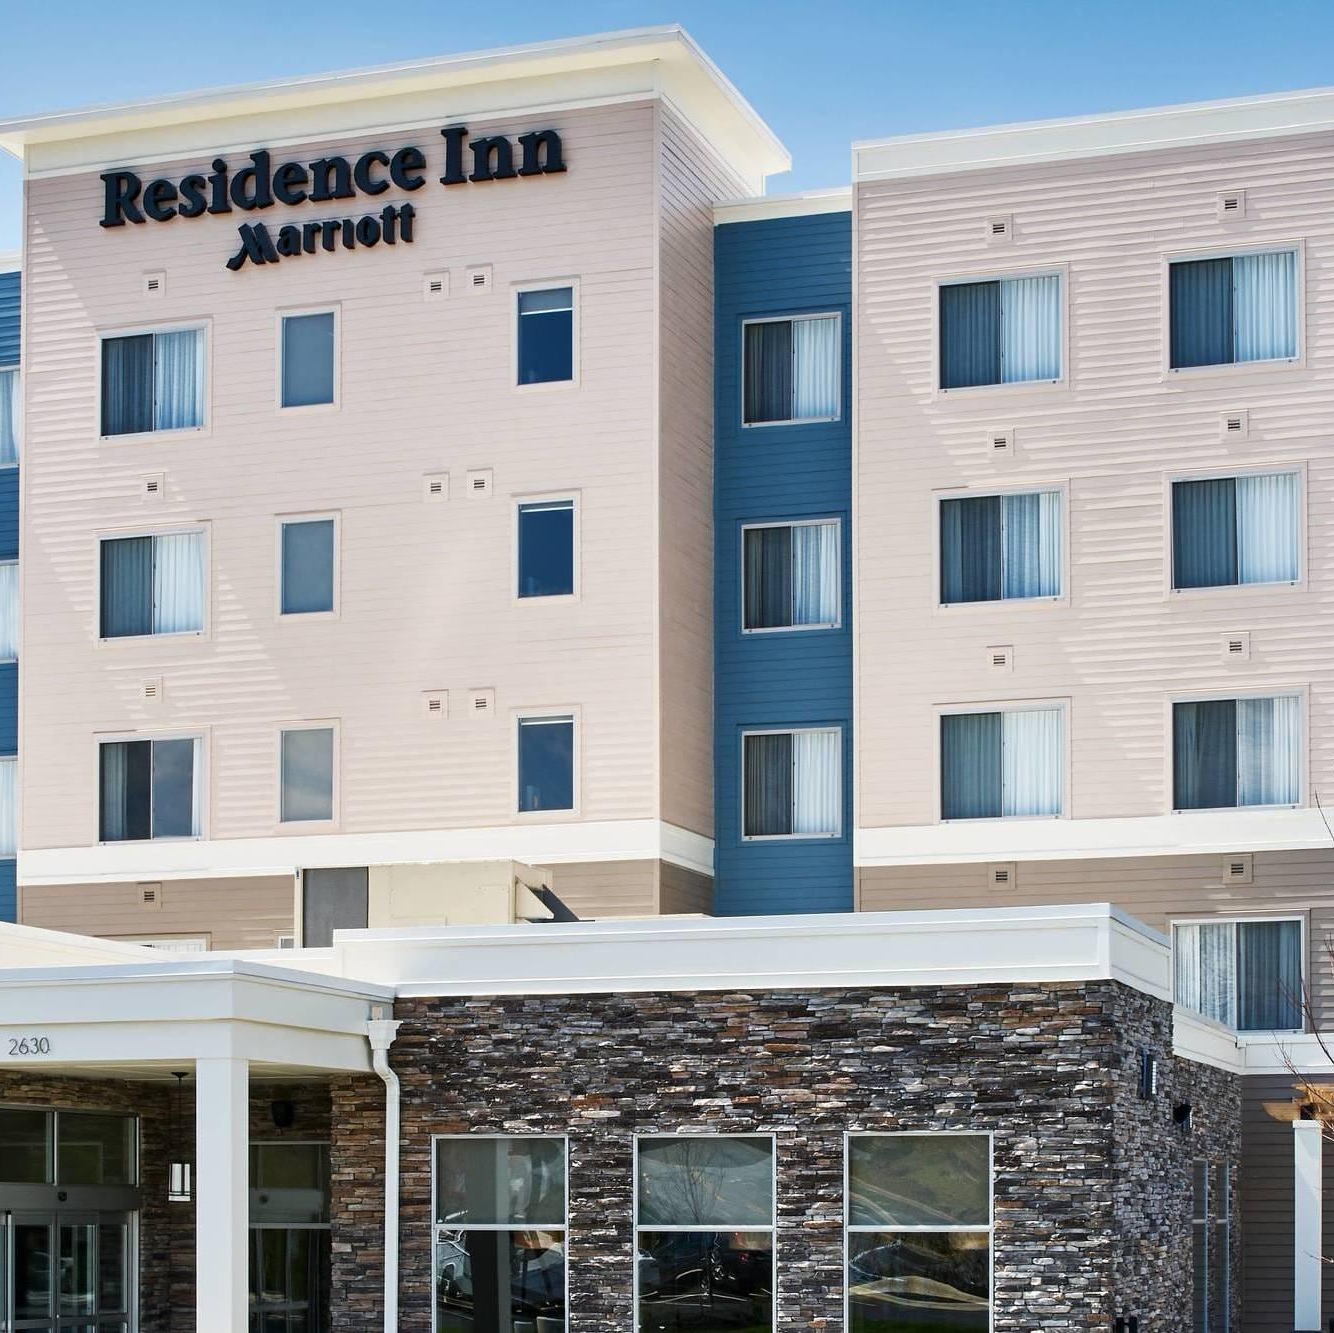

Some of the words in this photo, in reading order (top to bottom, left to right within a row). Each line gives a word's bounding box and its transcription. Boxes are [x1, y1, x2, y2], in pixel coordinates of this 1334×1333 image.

[99, 147, 427, 229] Residence
[440, 125, 568, 186] Inn
[226, 203, 417, 271] Marriott
[8, 1036, 51, 1056] 2630
